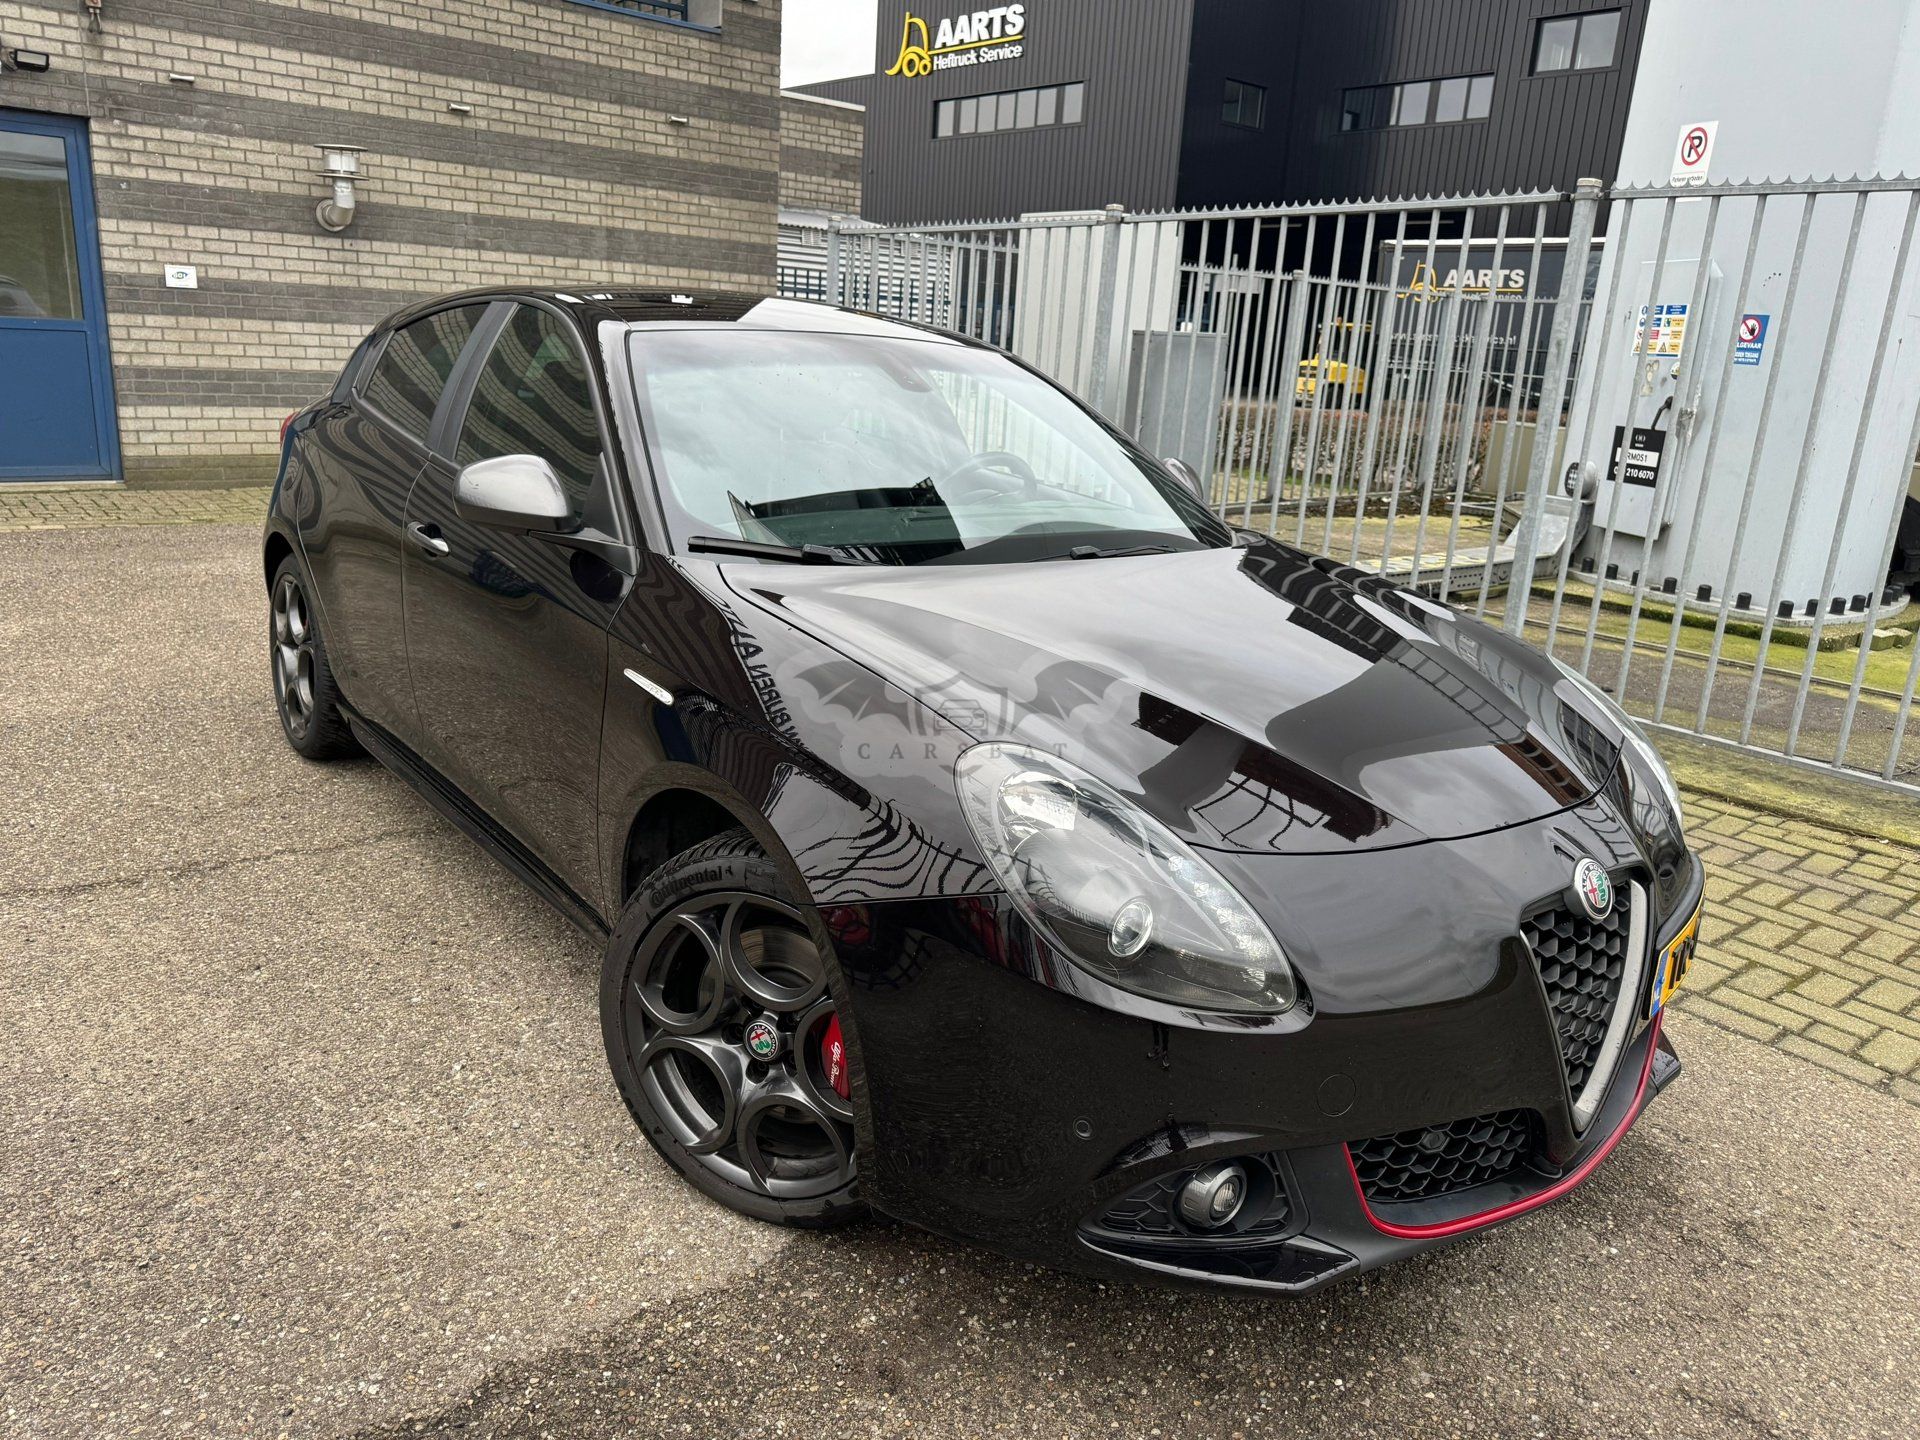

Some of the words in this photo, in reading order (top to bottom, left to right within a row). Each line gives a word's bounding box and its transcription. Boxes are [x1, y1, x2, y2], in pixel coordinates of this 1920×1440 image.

[934, 4, 1025, 48] AARTS
[933, 51, 978, 71] Heftruck
[979, 44, 1024, 63] Service
[1443, 269, 1525, 288] AARTS
[1626, 468, 1638, 478] 210
[1638, 469, 1655, 480] 6070
